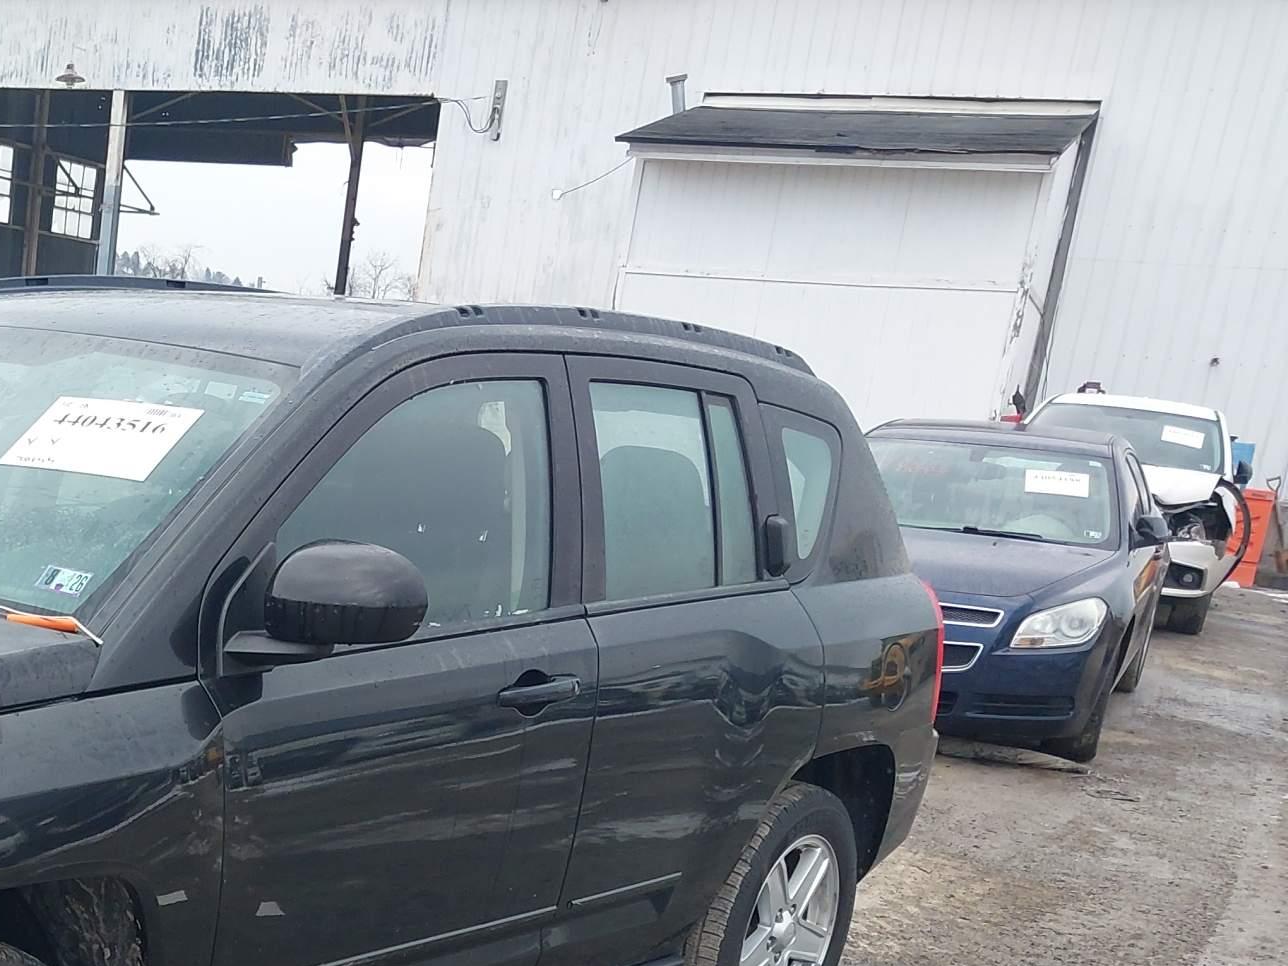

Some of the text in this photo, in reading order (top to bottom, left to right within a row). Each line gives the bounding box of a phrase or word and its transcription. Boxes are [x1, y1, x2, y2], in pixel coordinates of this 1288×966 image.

[53, 412, 168, 435] 44043516
[44, 568, 89, 592] 8 26
